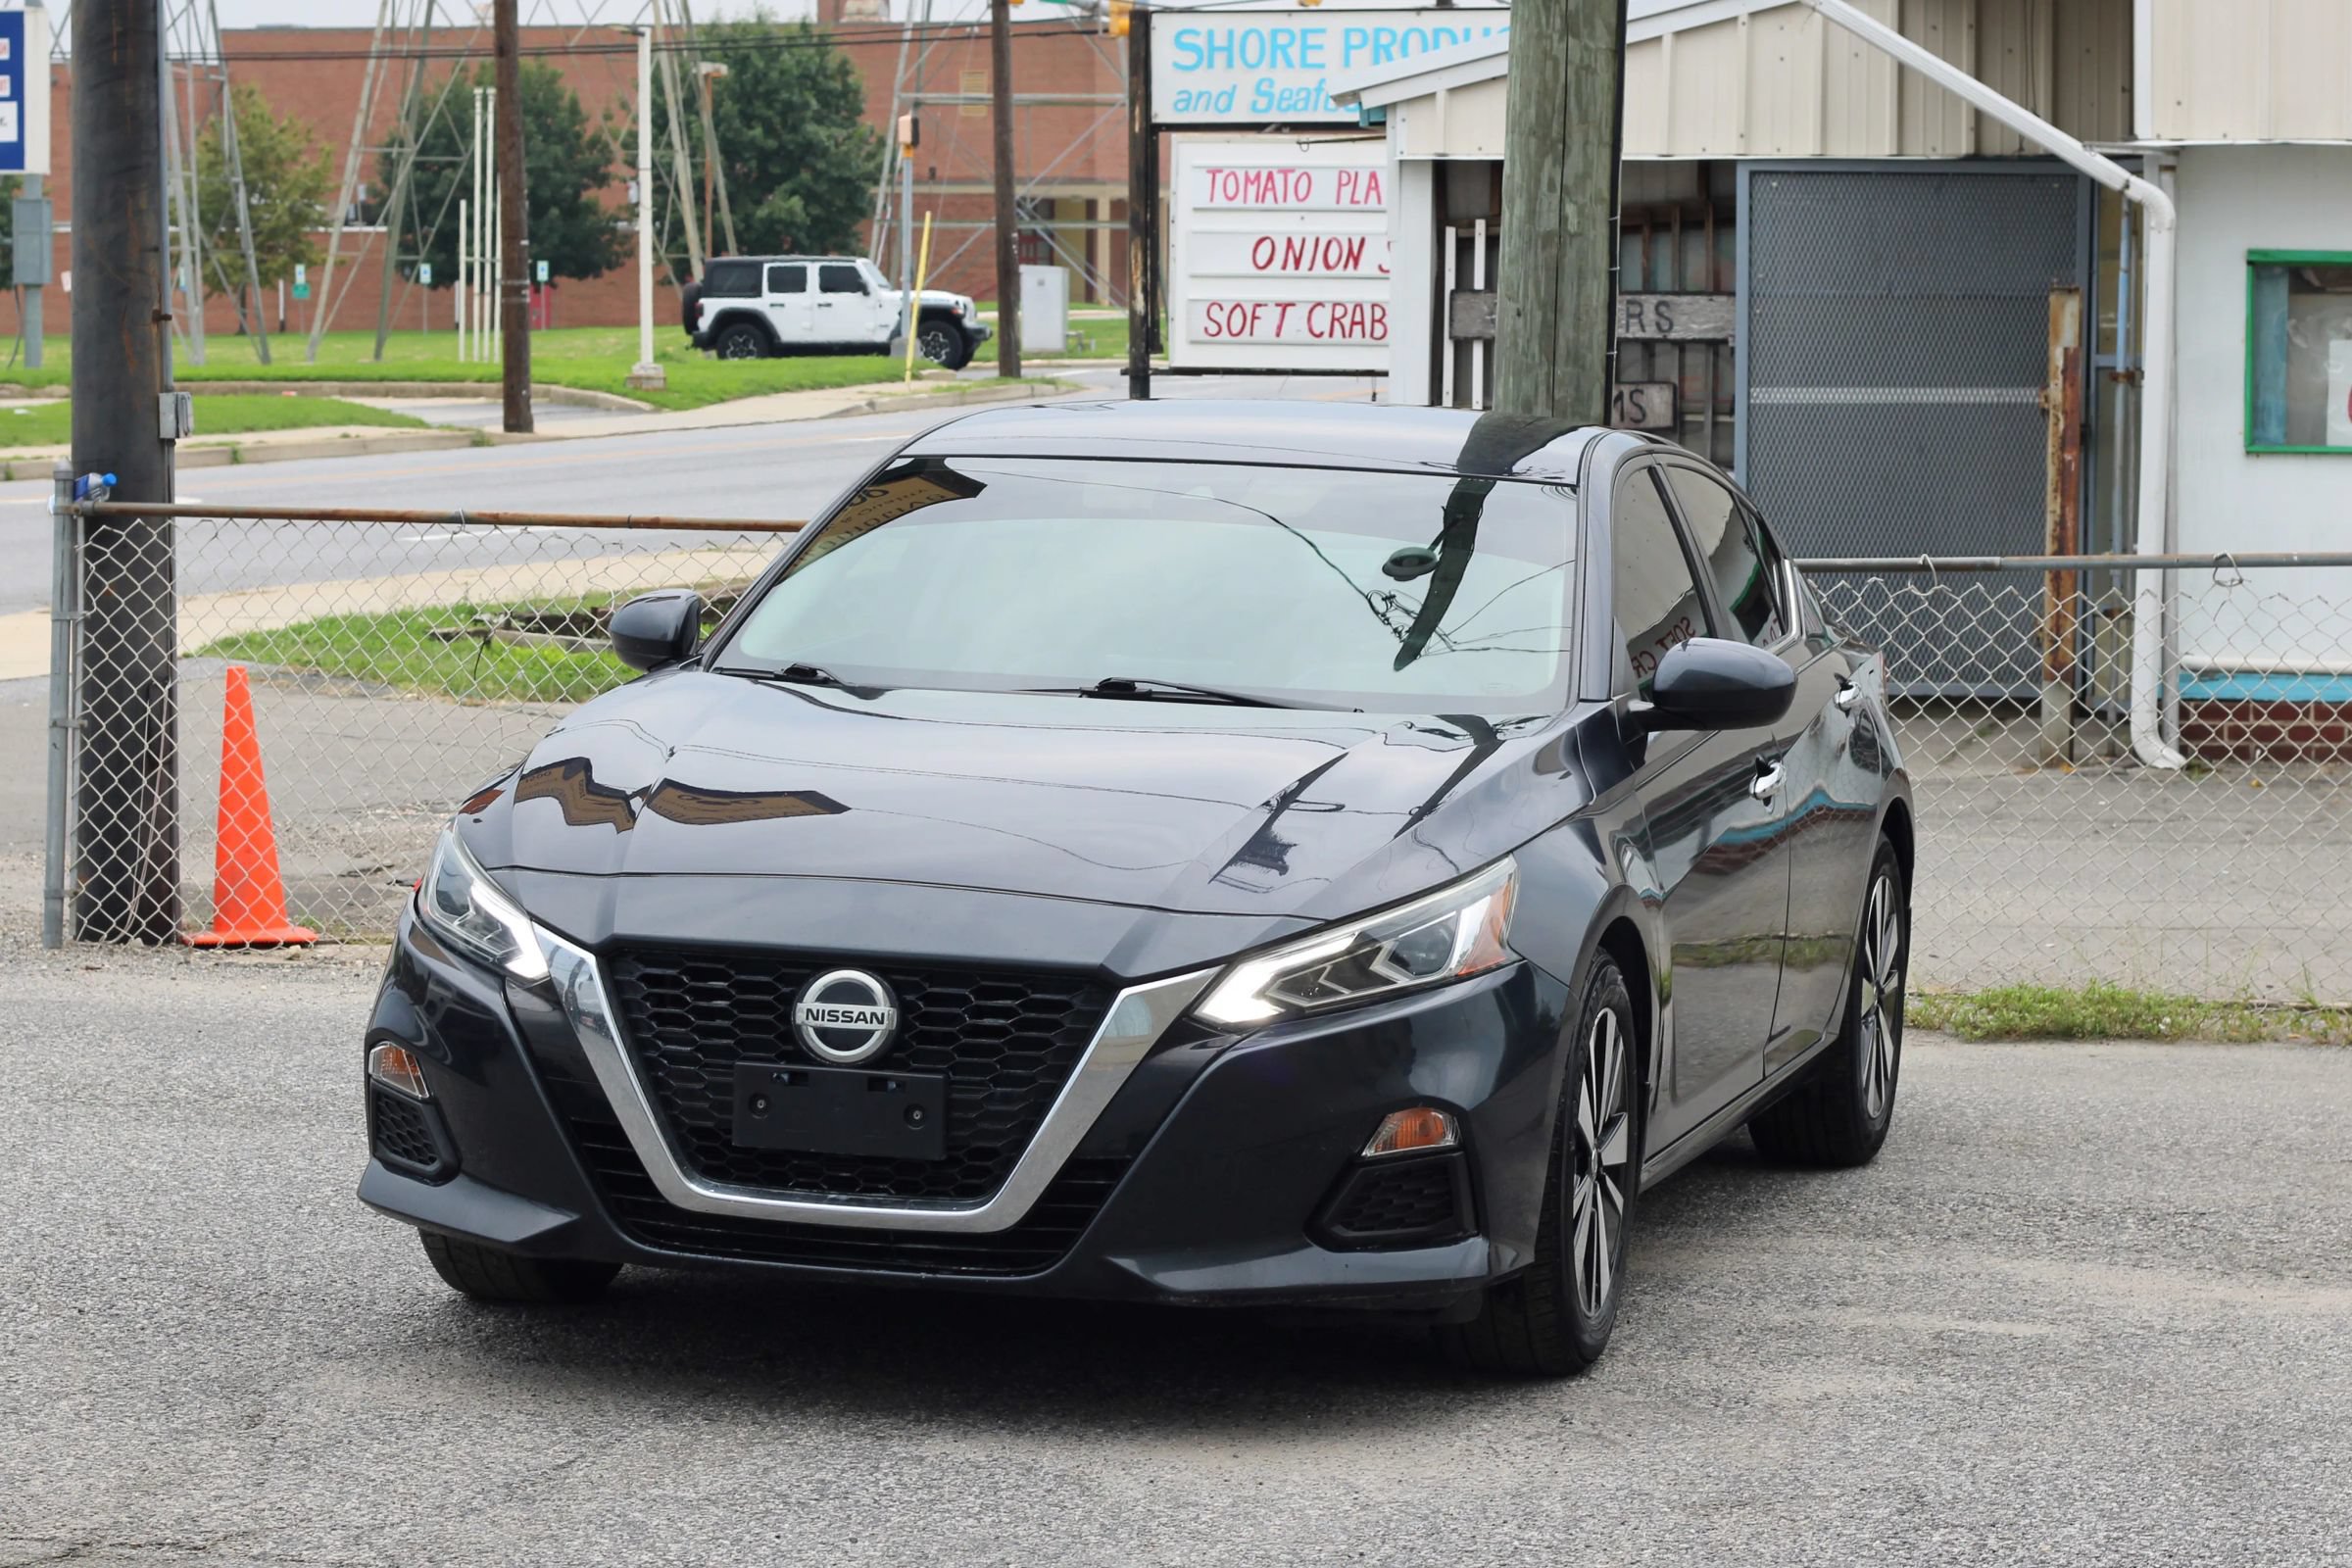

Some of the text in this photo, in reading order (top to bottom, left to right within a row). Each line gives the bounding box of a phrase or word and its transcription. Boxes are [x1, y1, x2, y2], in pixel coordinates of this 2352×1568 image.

[1171, 26, 1512, 72] SHORE PROD
[1172, 76, 1360, 114] and Seaf
[1206, 169, 1383, 205] TOMATO PLA
[1251, 235, 1366, 271] ONION
[1204, 301, 1389, 341] SOFT CRAB
[805, 1007, 886, 1026] NISSAN
